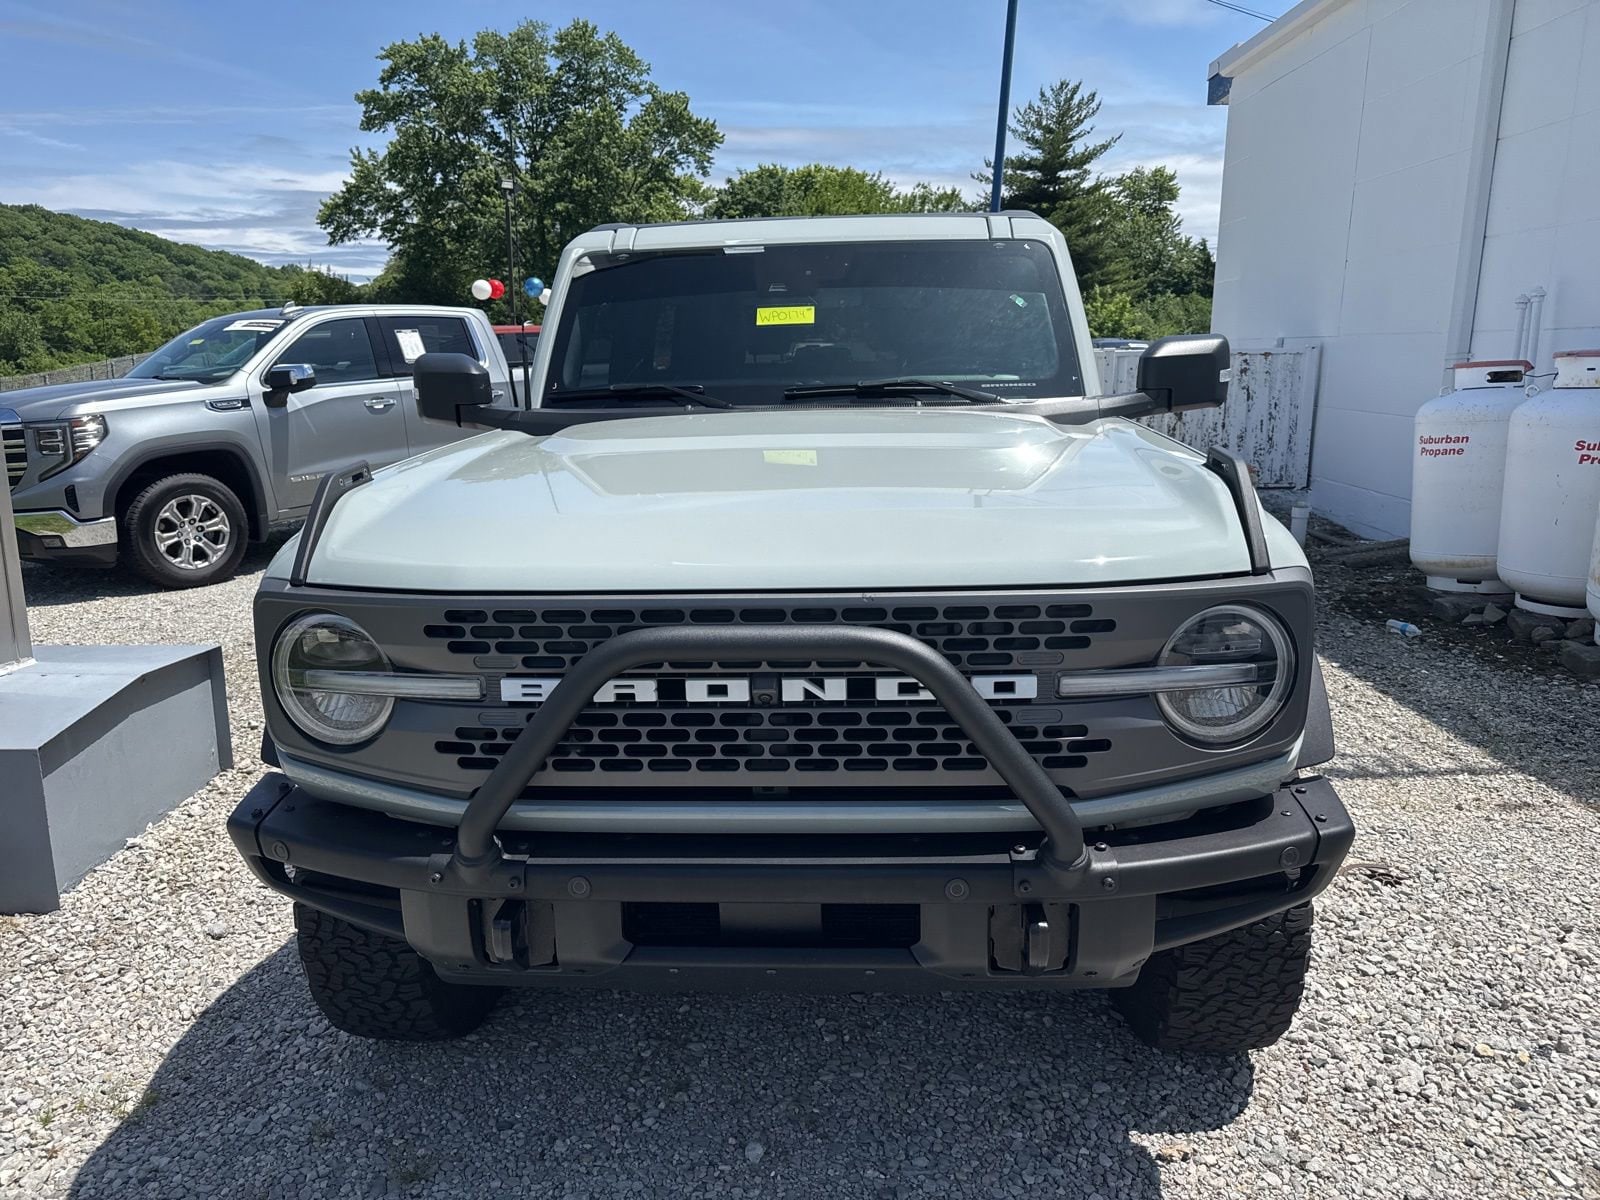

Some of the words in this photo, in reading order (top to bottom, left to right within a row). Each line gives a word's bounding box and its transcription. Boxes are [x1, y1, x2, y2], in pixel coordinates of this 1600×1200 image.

[1419, 434, 1469, 445] Suburban
[1420, 447, 1464, 457] Propane
[500, 677, 1038, 702] BRONCO
